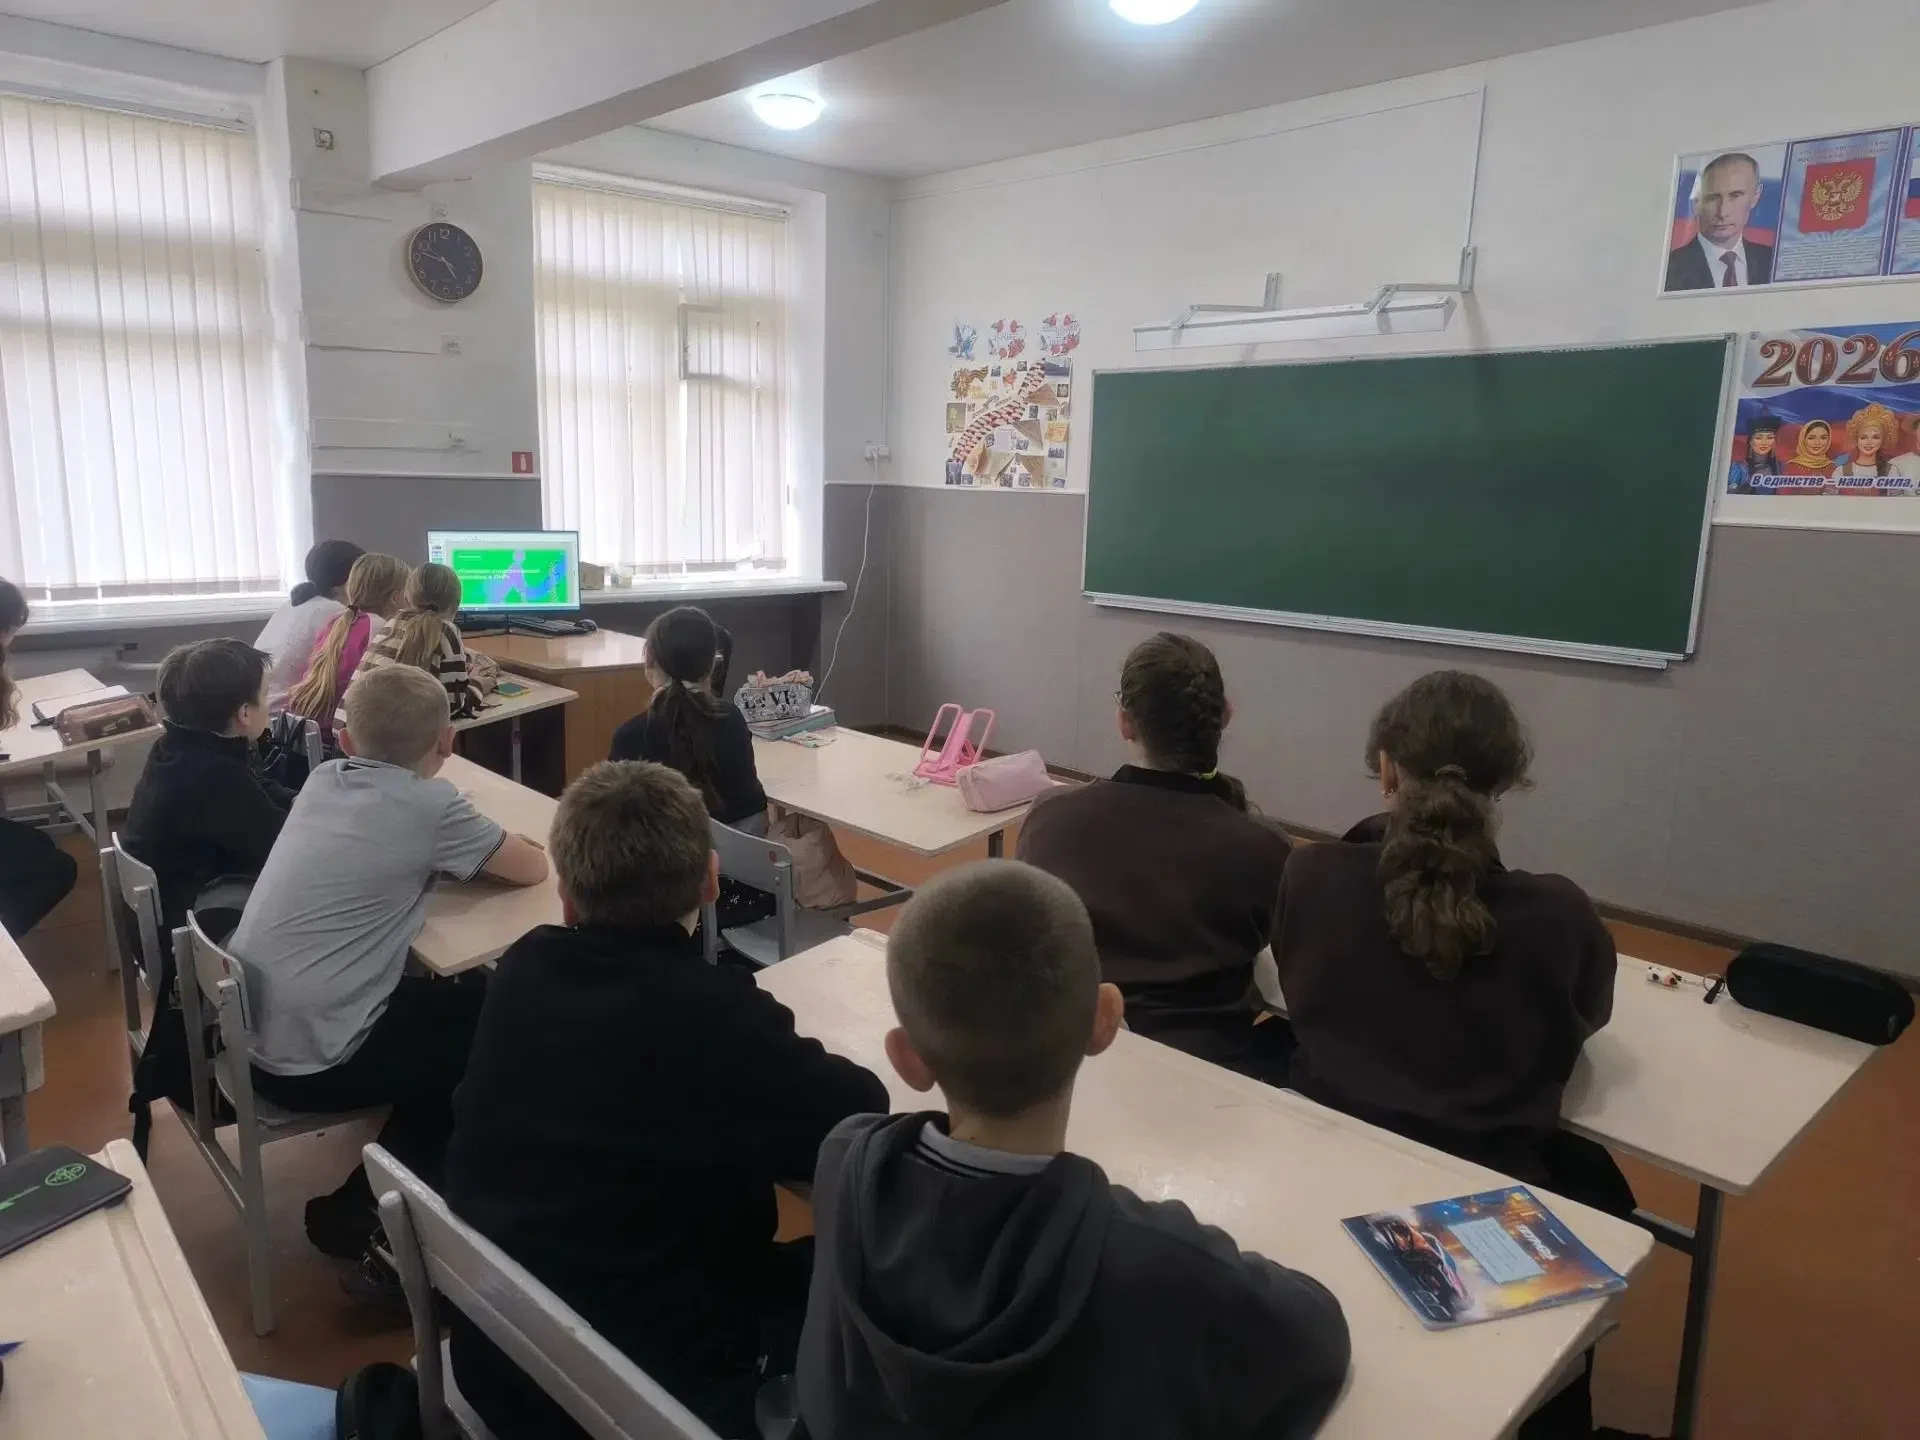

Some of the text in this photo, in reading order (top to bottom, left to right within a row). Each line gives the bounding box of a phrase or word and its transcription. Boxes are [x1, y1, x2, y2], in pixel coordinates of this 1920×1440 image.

[428, 231, 437, 242] 11
[1751, 330, 1920, 387] 2026
[1751, 475, 1761, 486] В
[1763, 476, 1824, 487] единстве
[1838, 477, 1873, 487] наша
[1876, 478, 1913, 488] сила,
